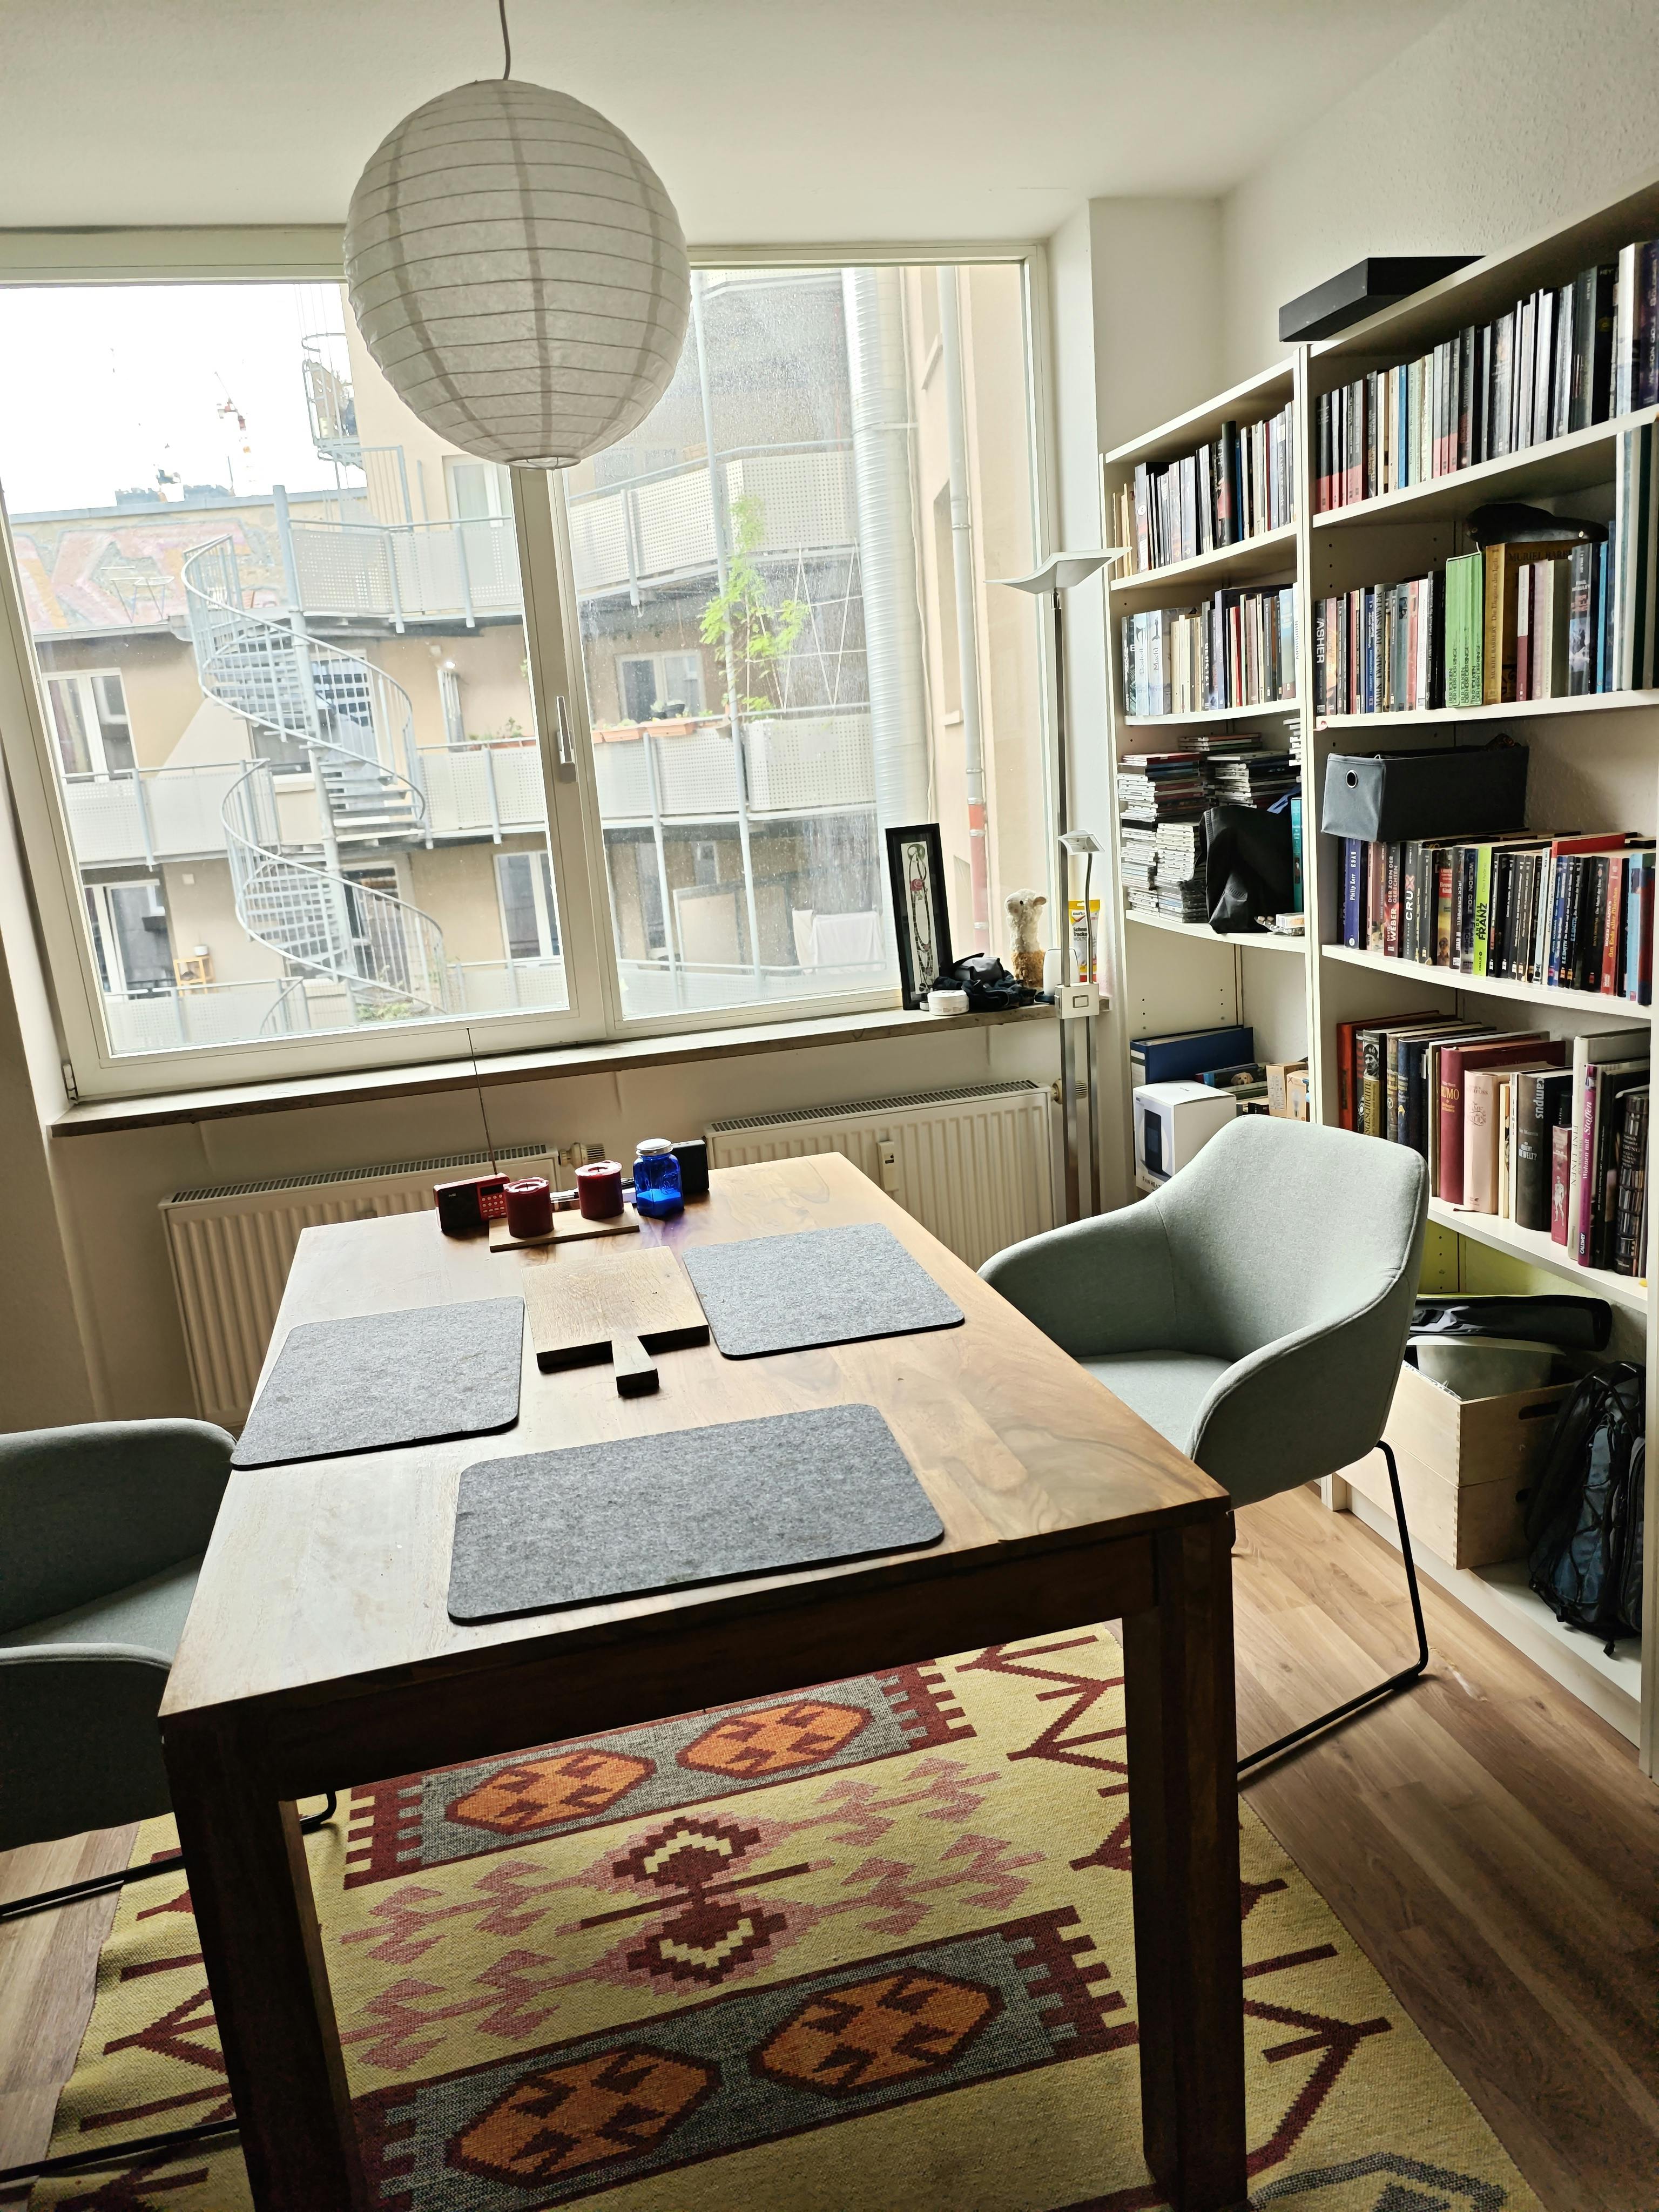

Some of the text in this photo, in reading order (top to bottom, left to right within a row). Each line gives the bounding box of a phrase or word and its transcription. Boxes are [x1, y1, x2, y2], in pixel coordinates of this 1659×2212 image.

[1316, 621, 1325, 663] ASHER
[1405, 875, 1415, 921] CRUX
[1478, 902, 1487, 941] FRANZ
[1608, 946, 1614, 957] Am
[1441, 1085, 1460, 1100] RUMO
[1533, 1078, 1545, 1120] campus
[1583, 1101, 1593, 1136] Stoffen
[1523, 1151, 1537, 1161] WELT?
